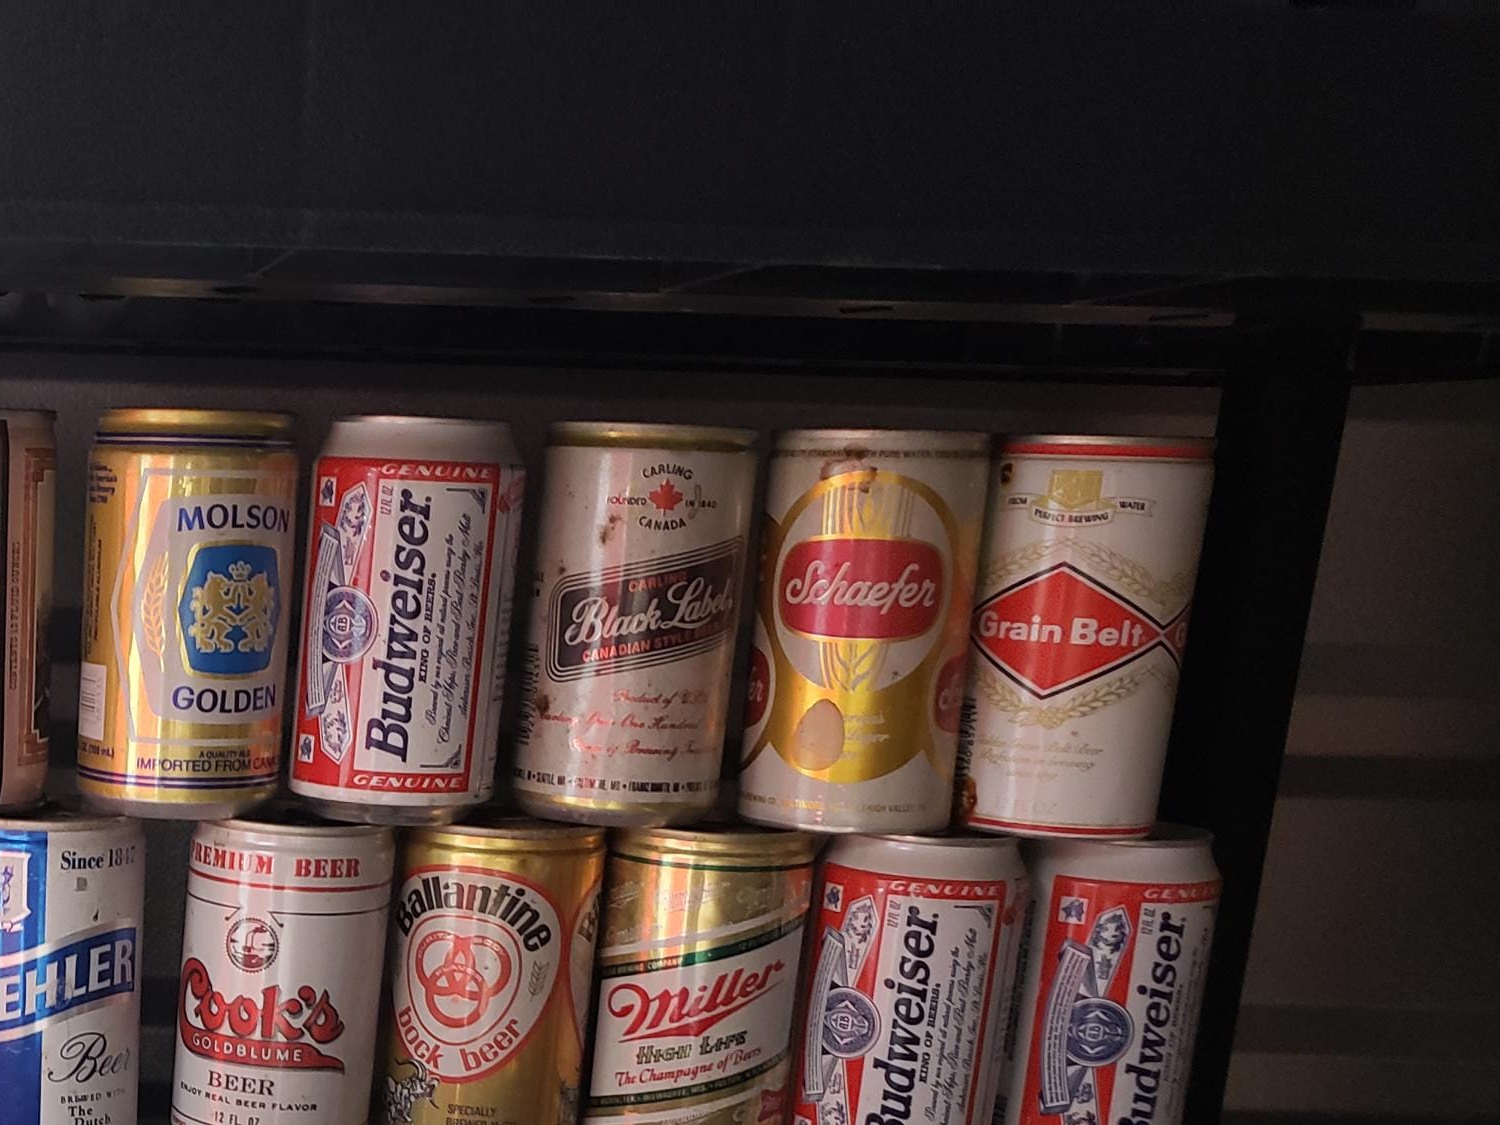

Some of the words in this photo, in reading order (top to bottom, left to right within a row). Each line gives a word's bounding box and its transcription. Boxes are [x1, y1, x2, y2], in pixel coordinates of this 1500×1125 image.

[381, 463, 493, 480] GENUINE
[643, 464, 694, 481] CARLING
[177, 504, 291, 534] MOLSON
[638, 516, 687, 531] CANADA
[1068, 511, 1110, 523] BREWING
[1118, 500, 1146, 511] WATER
[628, 571, 688, 593] CARLING
[784, 560, 938, 610] Schaefer
[564, 596, 664, 646] Black
[660, 577, 730, 629] Label
[421, 630, 432, 645] OF
[980, 609, 1062, 644] Grain
[1069, 615, 1143, 648] Belt
[582, 641, 650, 663] CANADIAN
[418, 657, 430, 683] KING
[171, 684, 276, 714] GOLDEN
[136, 757, 211, 772] IMPORTED
[213, 758, 250, 773] FROM
[352, 774, 464, 790] GENUINE
[60, 850, 104, 872] Since
[189, 839, 274, 877] PREMIUM
[295, 857, 361, 879] BEER
[889, 880, 1000, 898] GENUINE
[398, 875, 552, 954] Ballantine
[179, 956, 345, 1043] Cook's
[608, 960, 786, 1041] Miller
[192, 1032, 303, 1063] GOLDBLUME
[397, 1007, 445, 1071] bock
[460, 1017, 520, 1073] beer
[637, 1044, 693, 1065] HIGH
[699, 1031, 748, 1055] LIFE
[48, 1031, 131, 1085] Beer
[615, 1071, 637, 1087] The
[639, 1062, 714, 1084] Champagne
[717, 1055, 731, 1072] of
[731, 1048, 762, 1066] Beers
[208, 1070, 275, 1097] BEER
[919, 1060, 931, 1083] KING
[180, 1081, 202, 1097] ENJOY
[205, 1091, 231, 1105] REAL
[235, 1098, 266, 1110] BEER
[271, 1103, 318, 1112] FLAVOR
[68, 1105, 93, 1118] The
[213, 1111, 224, 1125] 12
[447, 1103, 498, 1117] SPECIALLY
